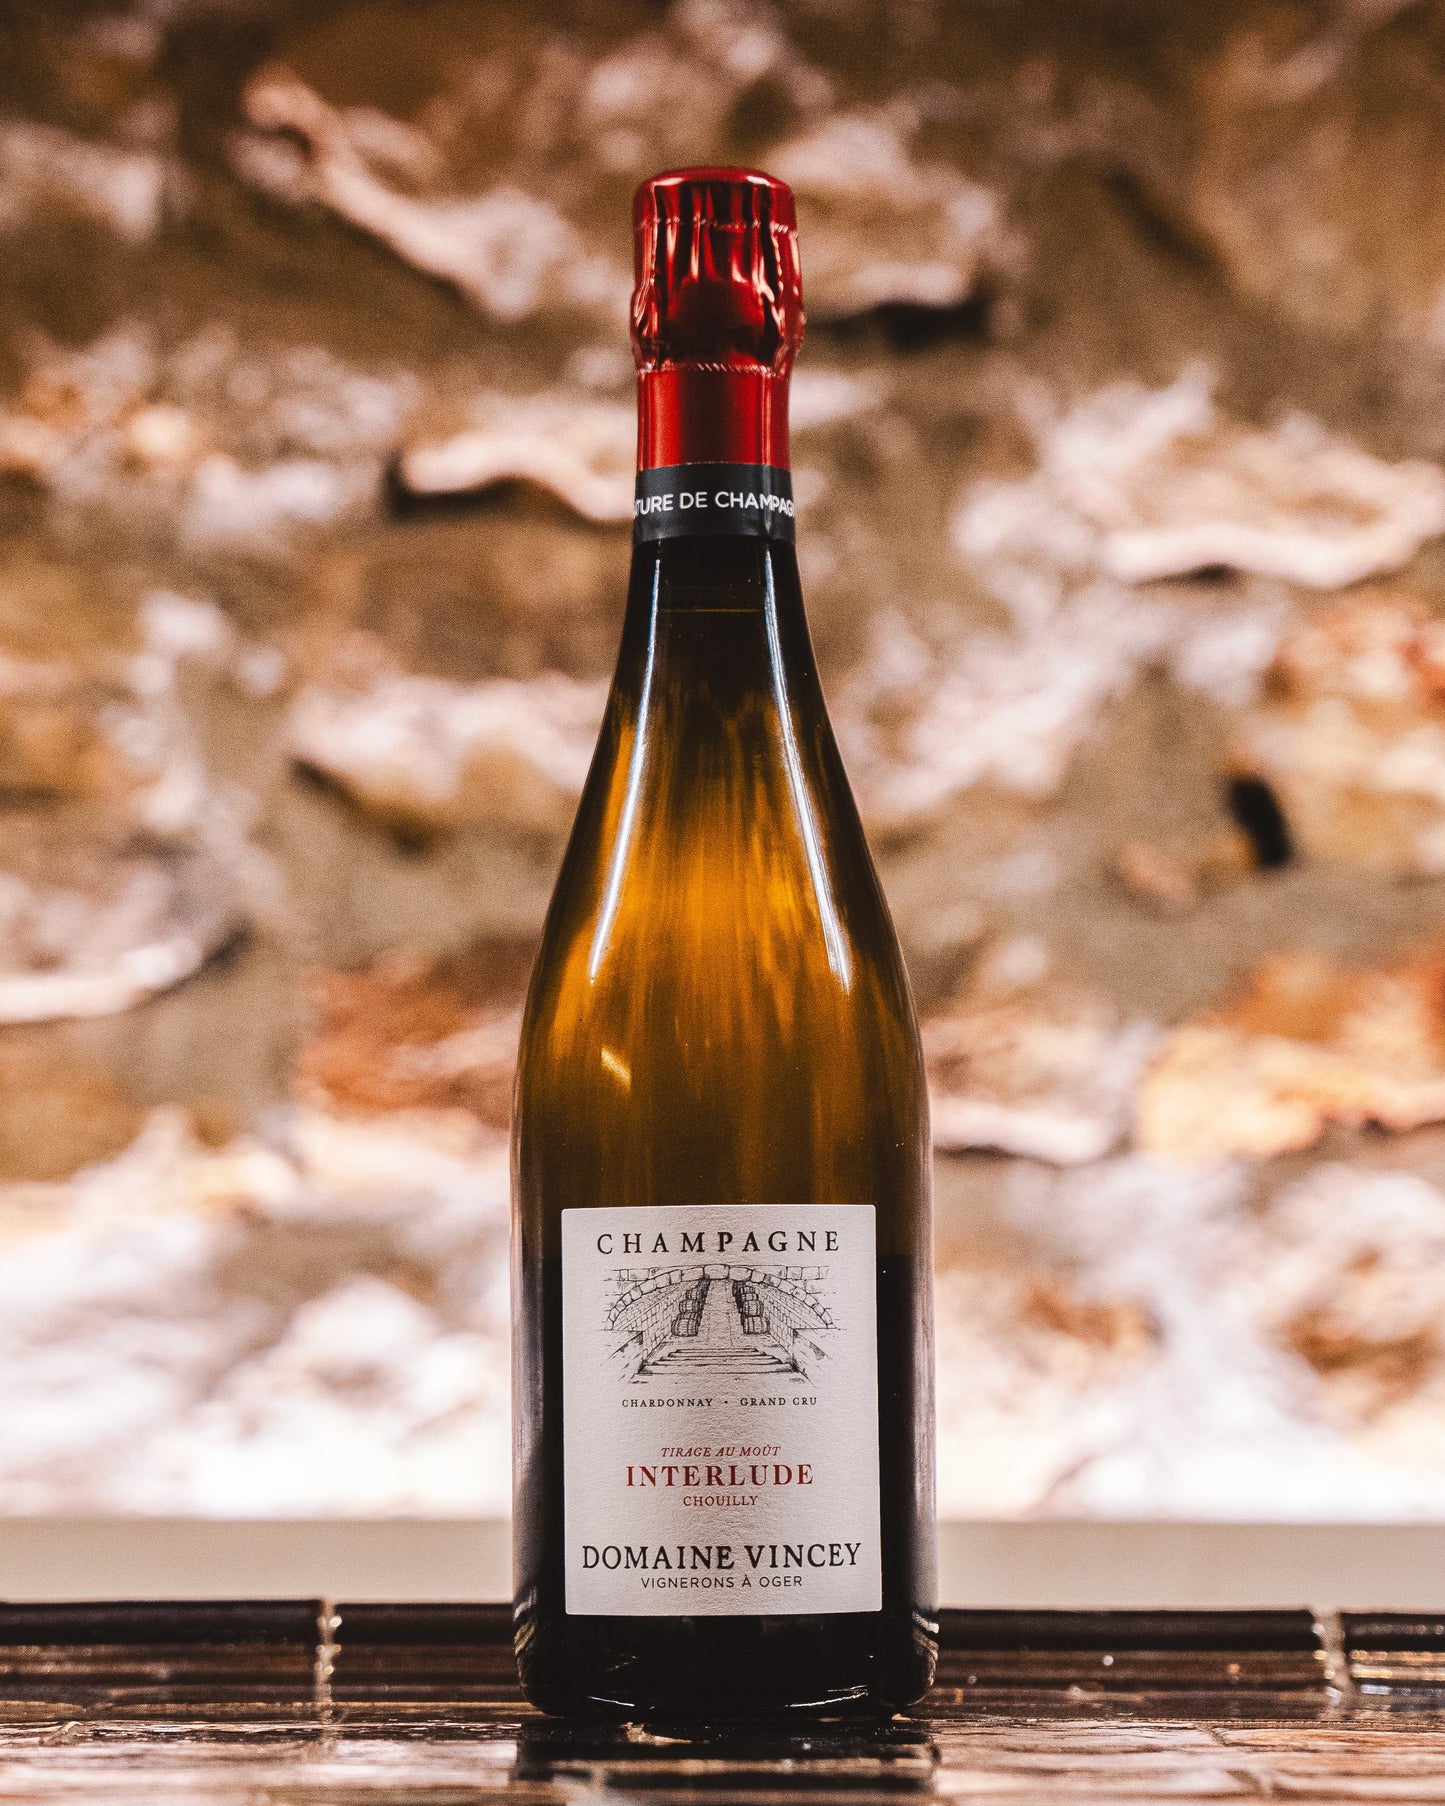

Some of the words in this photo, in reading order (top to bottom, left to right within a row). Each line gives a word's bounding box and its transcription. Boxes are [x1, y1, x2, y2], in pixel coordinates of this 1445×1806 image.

[679, 491, 708, 509] DE
[714, 491, 794, 517] CHAMPAG
[597, 1230, 840, 1254] CHAMPAGNE
[622, 1398, 713, 1408] CHARDONNAY
[740, 1397, 786, 1407] GRAND
[792, 1396, 818, 1406] CRU
[661, 1447, 712, 1457] TIRAGE
[715, 1446, 735, 1457] AU
[739, 1444, 781, 1457] MOÛT
[626, 1463, 814, 1487] INTERLUDE
[683, 1495, 758, 1507] CHOUILLY
[582, 1545, 735, 1570] DOMAINE
[744, 1542, 862, 1569] VINCEY
[641, 1576, 734, 1589] VIGNERONS
[741, 1574, 753, 1588] À
[759, 1575, 802, 1588] OGER
